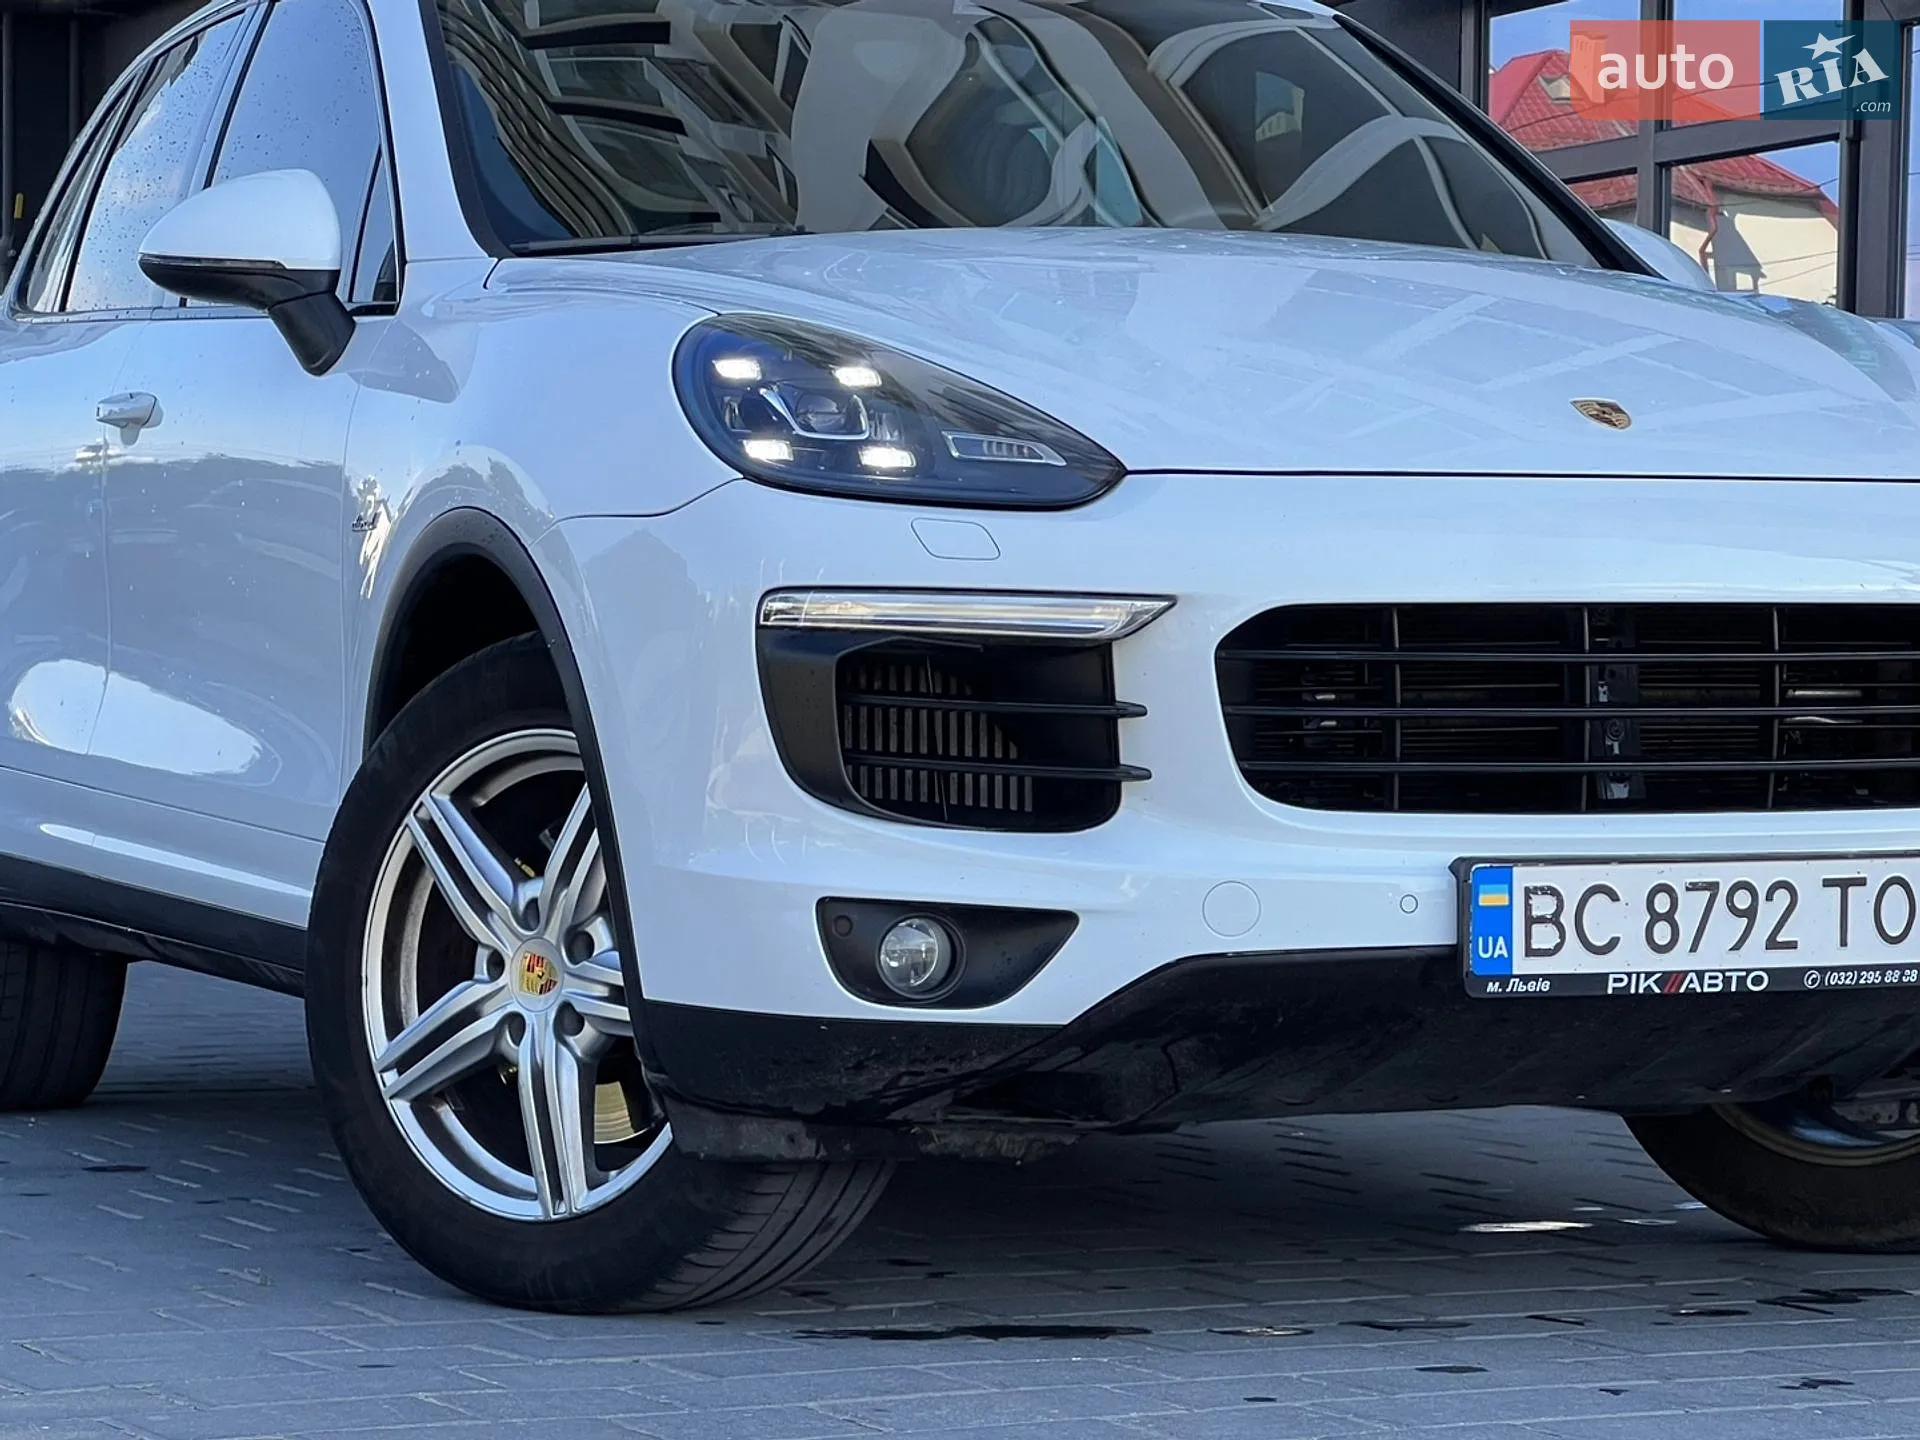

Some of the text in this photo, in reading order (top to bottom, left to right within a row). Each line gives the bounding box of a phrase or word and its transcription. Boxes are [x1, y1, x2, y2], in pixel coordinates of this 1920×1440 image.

[1523, 875, 1917, 957] BC 8792 TO
[1478, 936, 1509, 959] UA
[1486, 977, 1551, 993] м. Львів
[1824, 970, 1858, 986] (032)
[1859, 970, 1882, 984] 295
